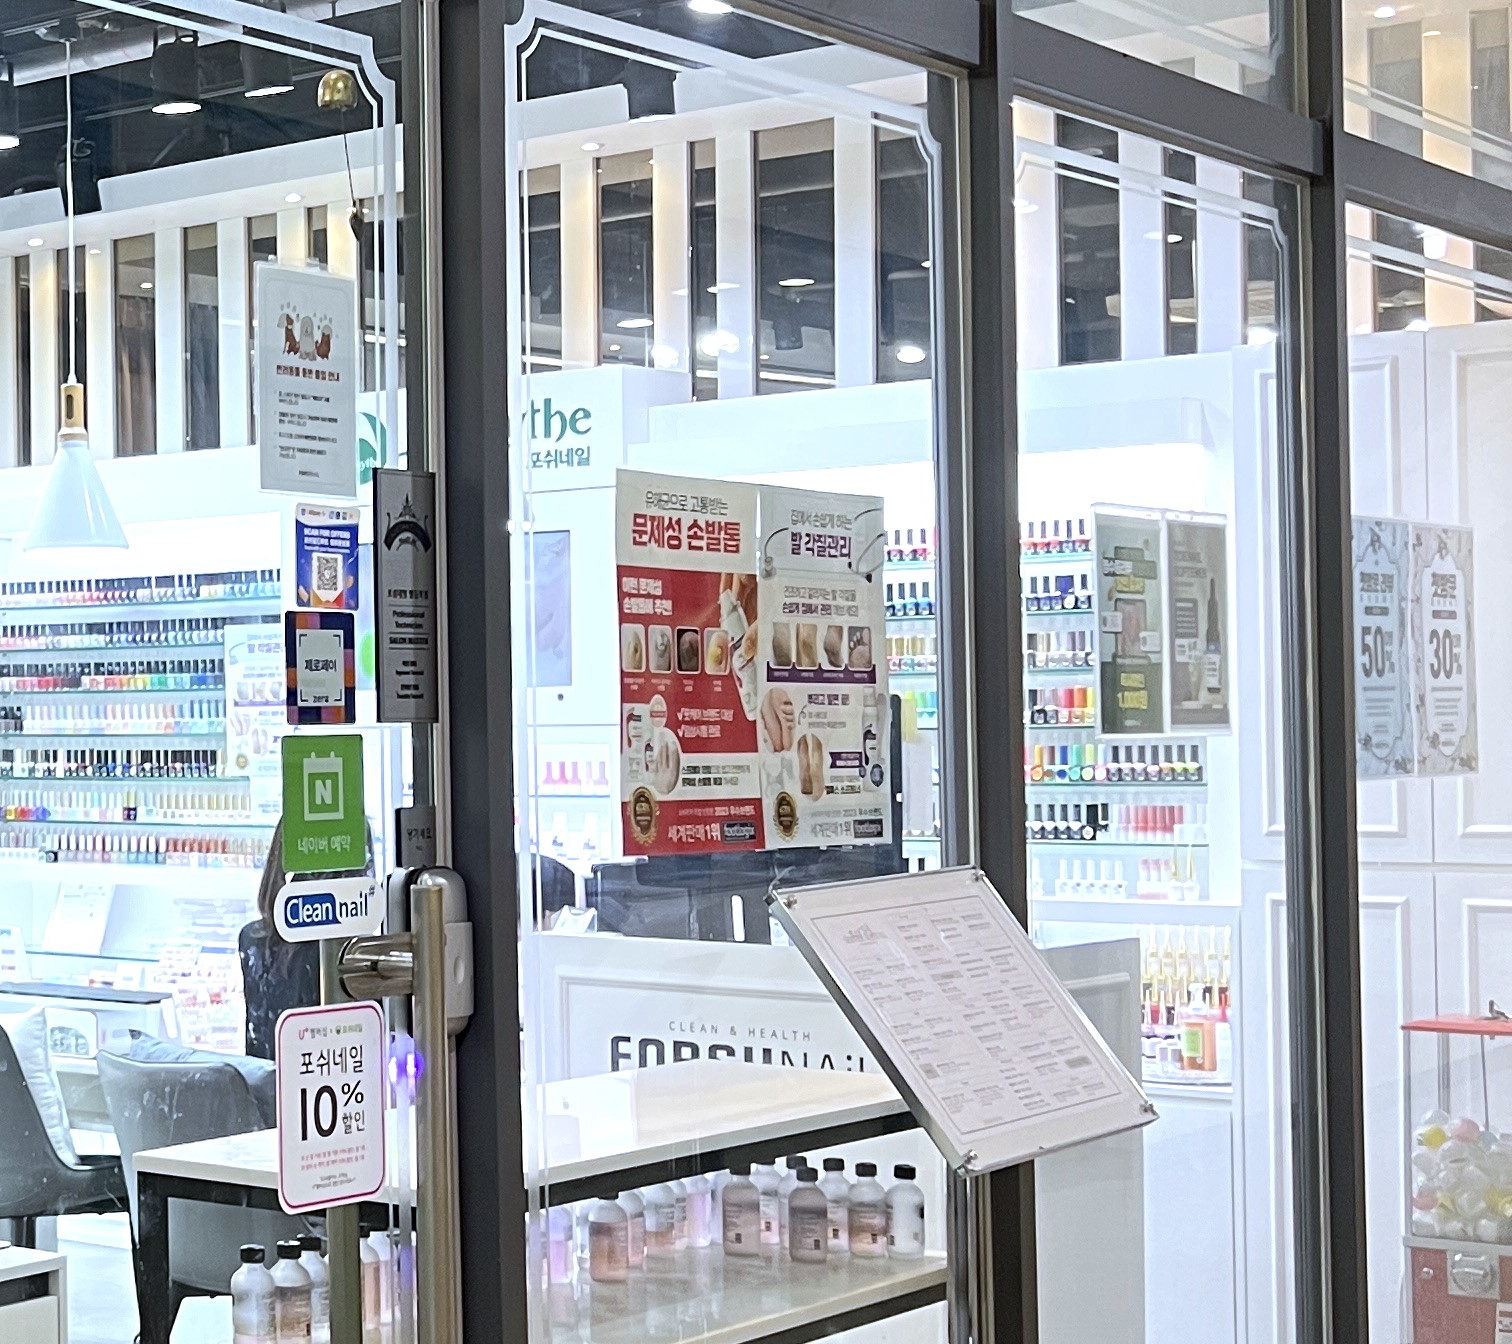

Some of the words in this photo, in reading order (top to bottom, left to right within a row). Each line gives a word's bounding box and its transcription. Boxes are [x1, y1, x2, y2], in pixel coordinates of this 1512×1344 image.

[632, 513, 682, 550] 문제성
[687, 518, 741, 554] 손발톱
[790, 531, 802, 556] 발
[804, 532, 852, 560] 각질관리
[315, 779, 332, 805] N
[286, 897, 333, 924] Clean
[339, 890, 368, 918] nail
[668, 1021, 719, 1035] CLEAN
[729, 1026, 738, 1036] &
[747, 1027, 812, 1042] HEALTH
[299, 1044, 364, 1077] 포쉬네일
[342, 1110, 366, 1135] 할인
